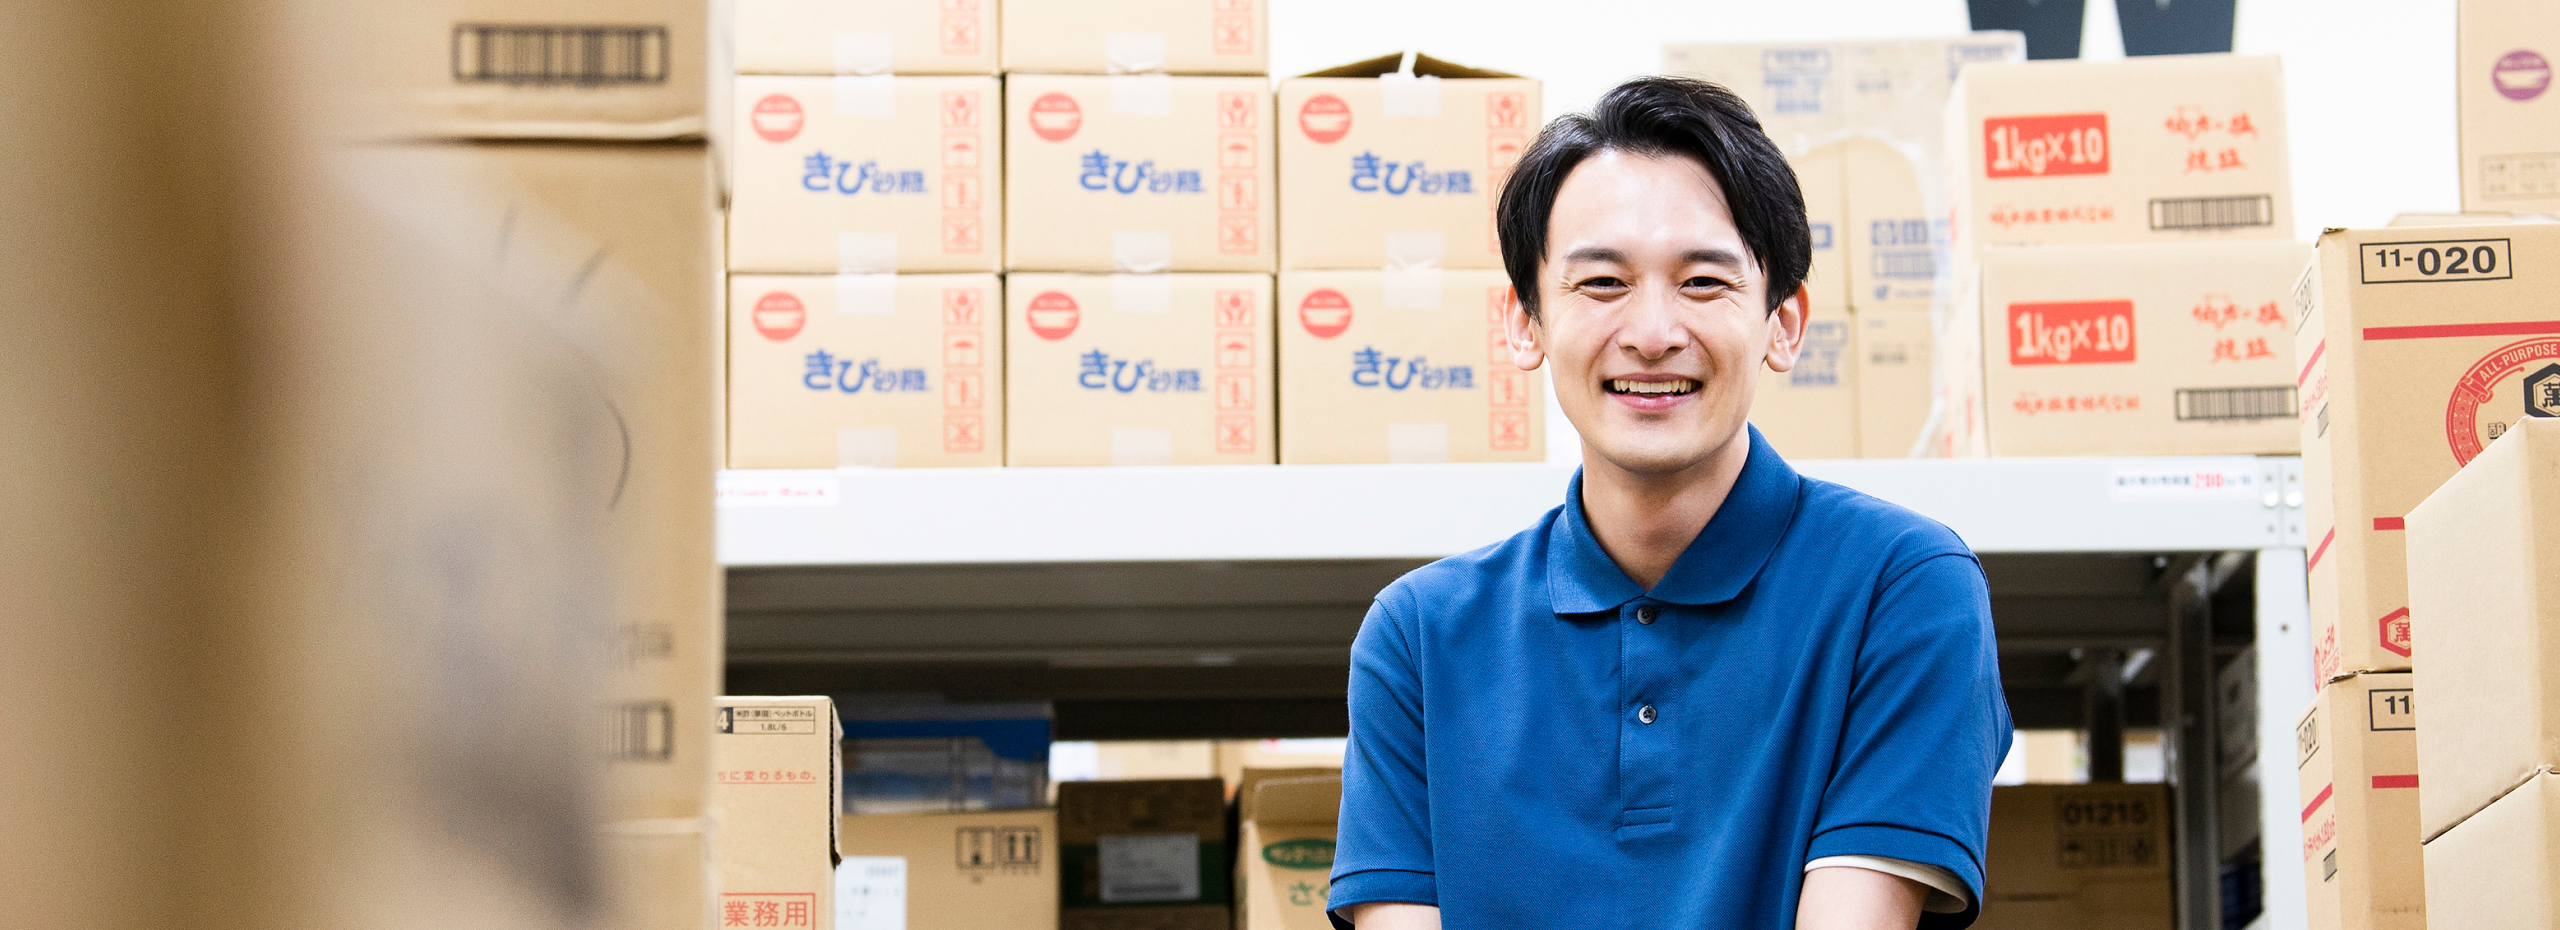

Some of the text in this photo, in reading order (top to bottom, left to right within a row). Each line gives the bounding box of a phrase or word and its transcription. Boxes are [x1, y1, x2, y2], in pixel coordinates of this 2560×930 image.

[2376, 245, 2496, 276] 11-020
[2479, 343, 2558, 381] ALL-PURPOSE
[2384, 695, 2415, 715] 11
[724, 901, 807, 927] 業務用
